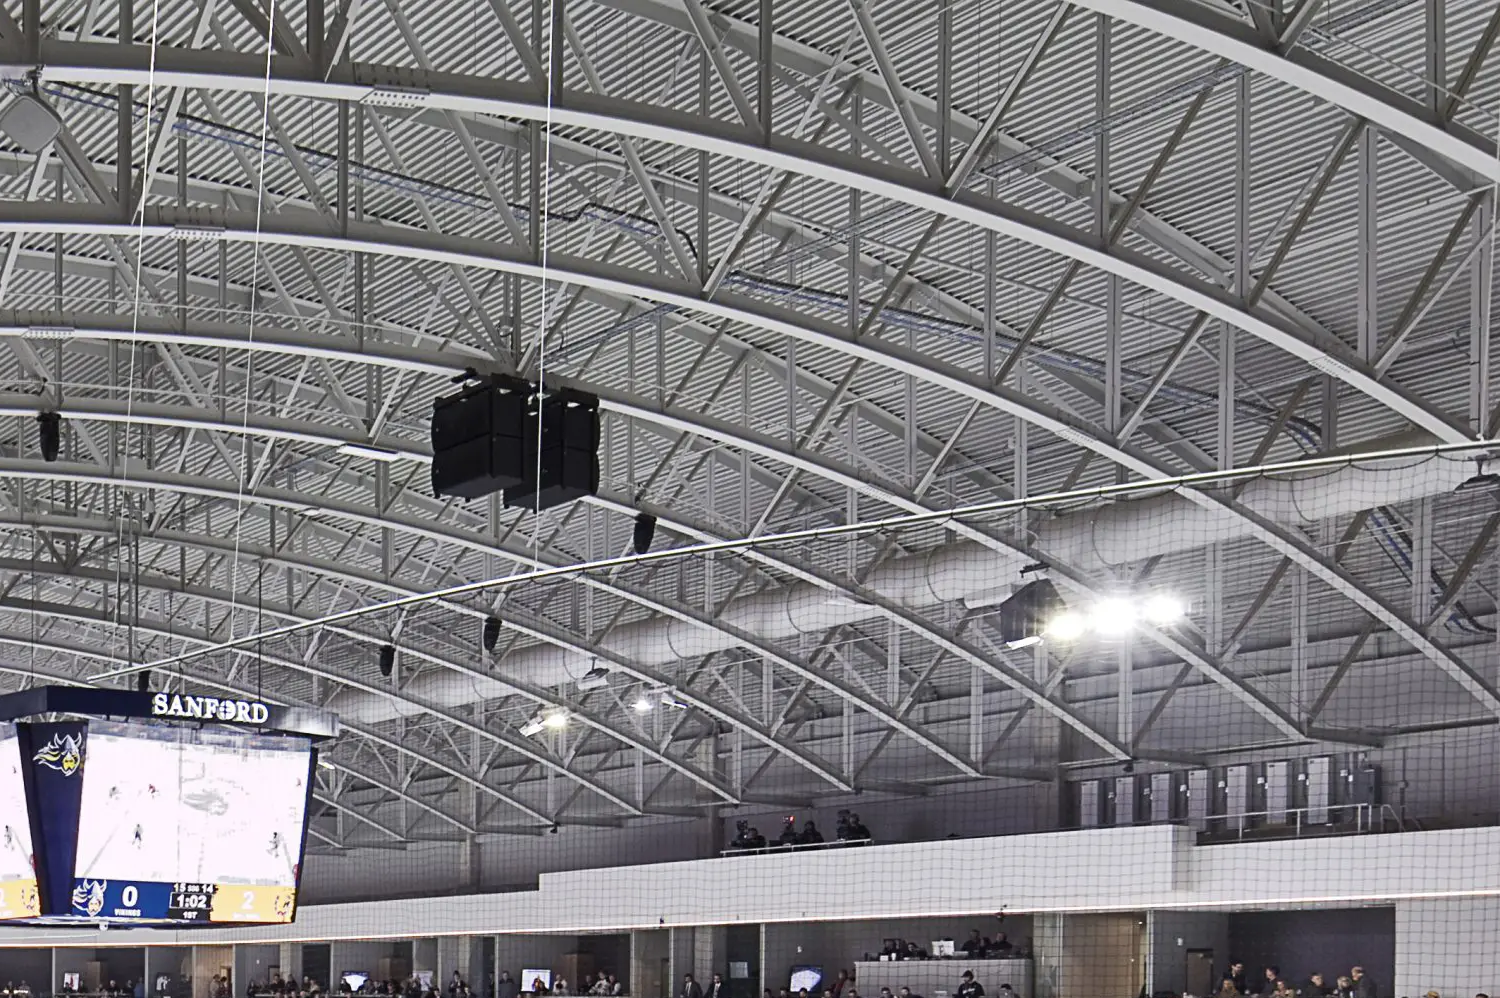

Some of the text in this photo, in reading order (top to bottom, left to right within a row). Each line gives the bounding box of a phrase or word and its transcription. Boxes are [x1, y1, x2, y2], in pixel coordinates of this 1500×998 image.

[153, 692, 268, 724] SANFORD
[173, 882, 186, 892] 15
[202, 884, 213, 893] 14
[122, 885, 138, 907] 0
[177, 895, 207, 908] 1:02
[241, 890, 255, 910] 2
[182, 911, 198, 919] 1ST
